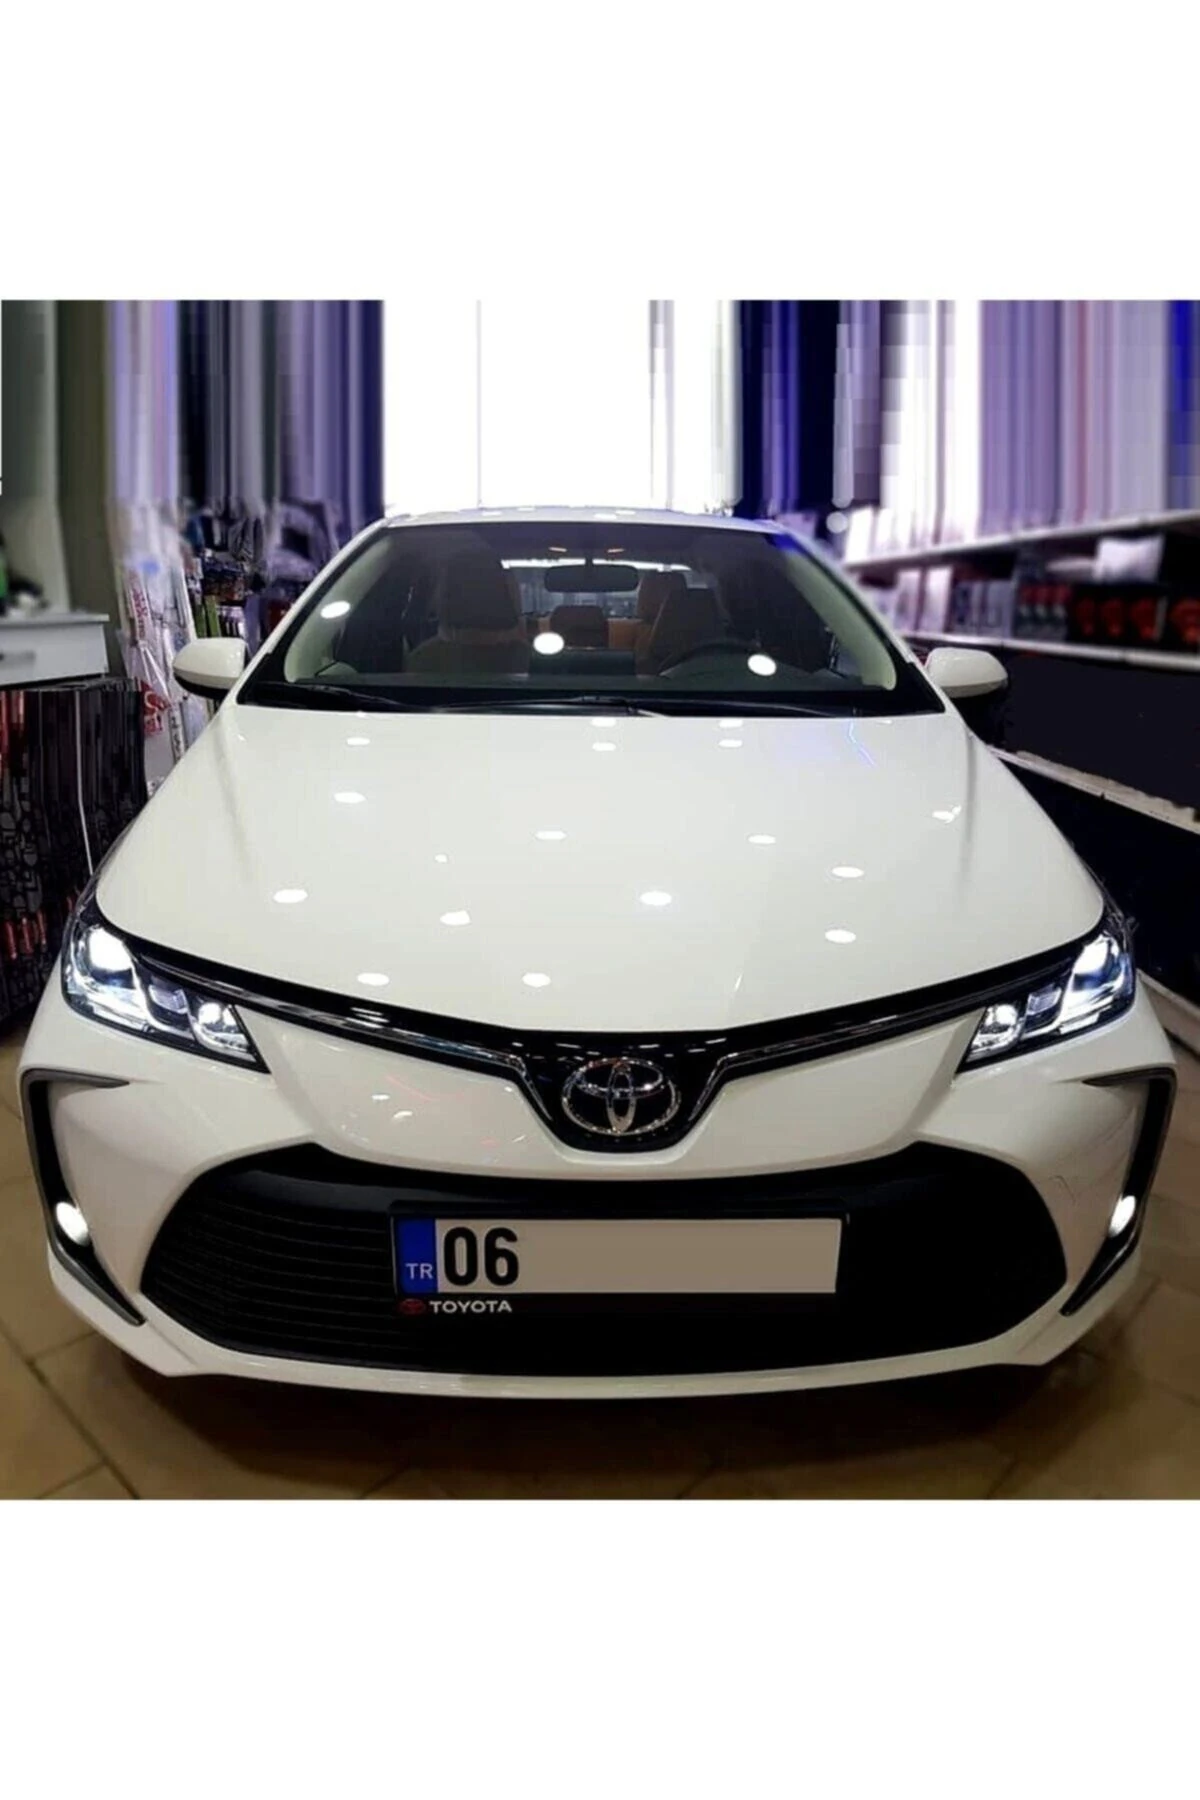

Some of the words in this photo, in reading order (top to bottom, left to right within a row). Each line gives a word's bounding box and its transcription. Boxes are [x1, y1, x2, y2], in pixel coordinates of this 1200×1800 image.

[405, 1263, 434, 1280] TR
[444, 1227, 519, 1287] 06
[430, 1300, 512, 1314] TOYOTA
